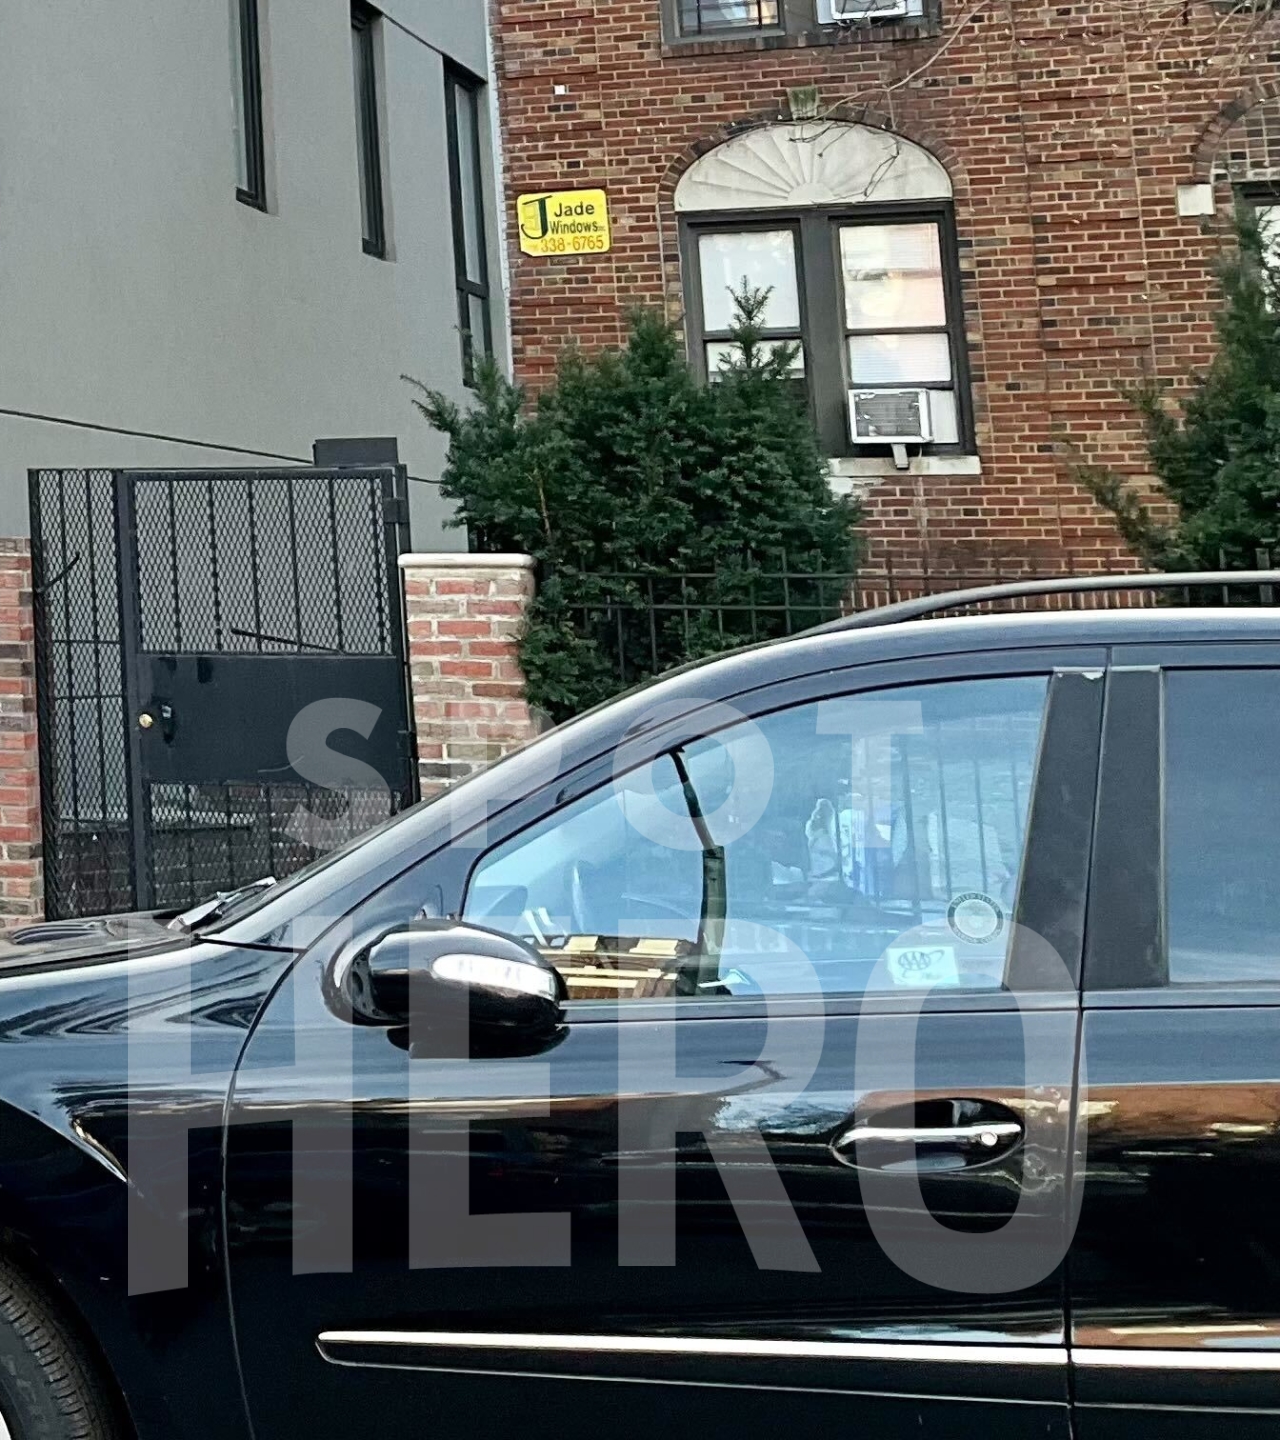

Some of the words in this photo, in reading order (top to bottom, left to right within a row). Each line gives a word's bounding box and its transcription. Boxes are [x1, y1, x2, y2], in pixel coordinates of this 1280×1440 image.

[554, 201, 595, 217] Jade
[549, 220, 598, 235] Windows
[540, 235, 604, 253] 338-6765
[900, 951, 929, 971] AAA
